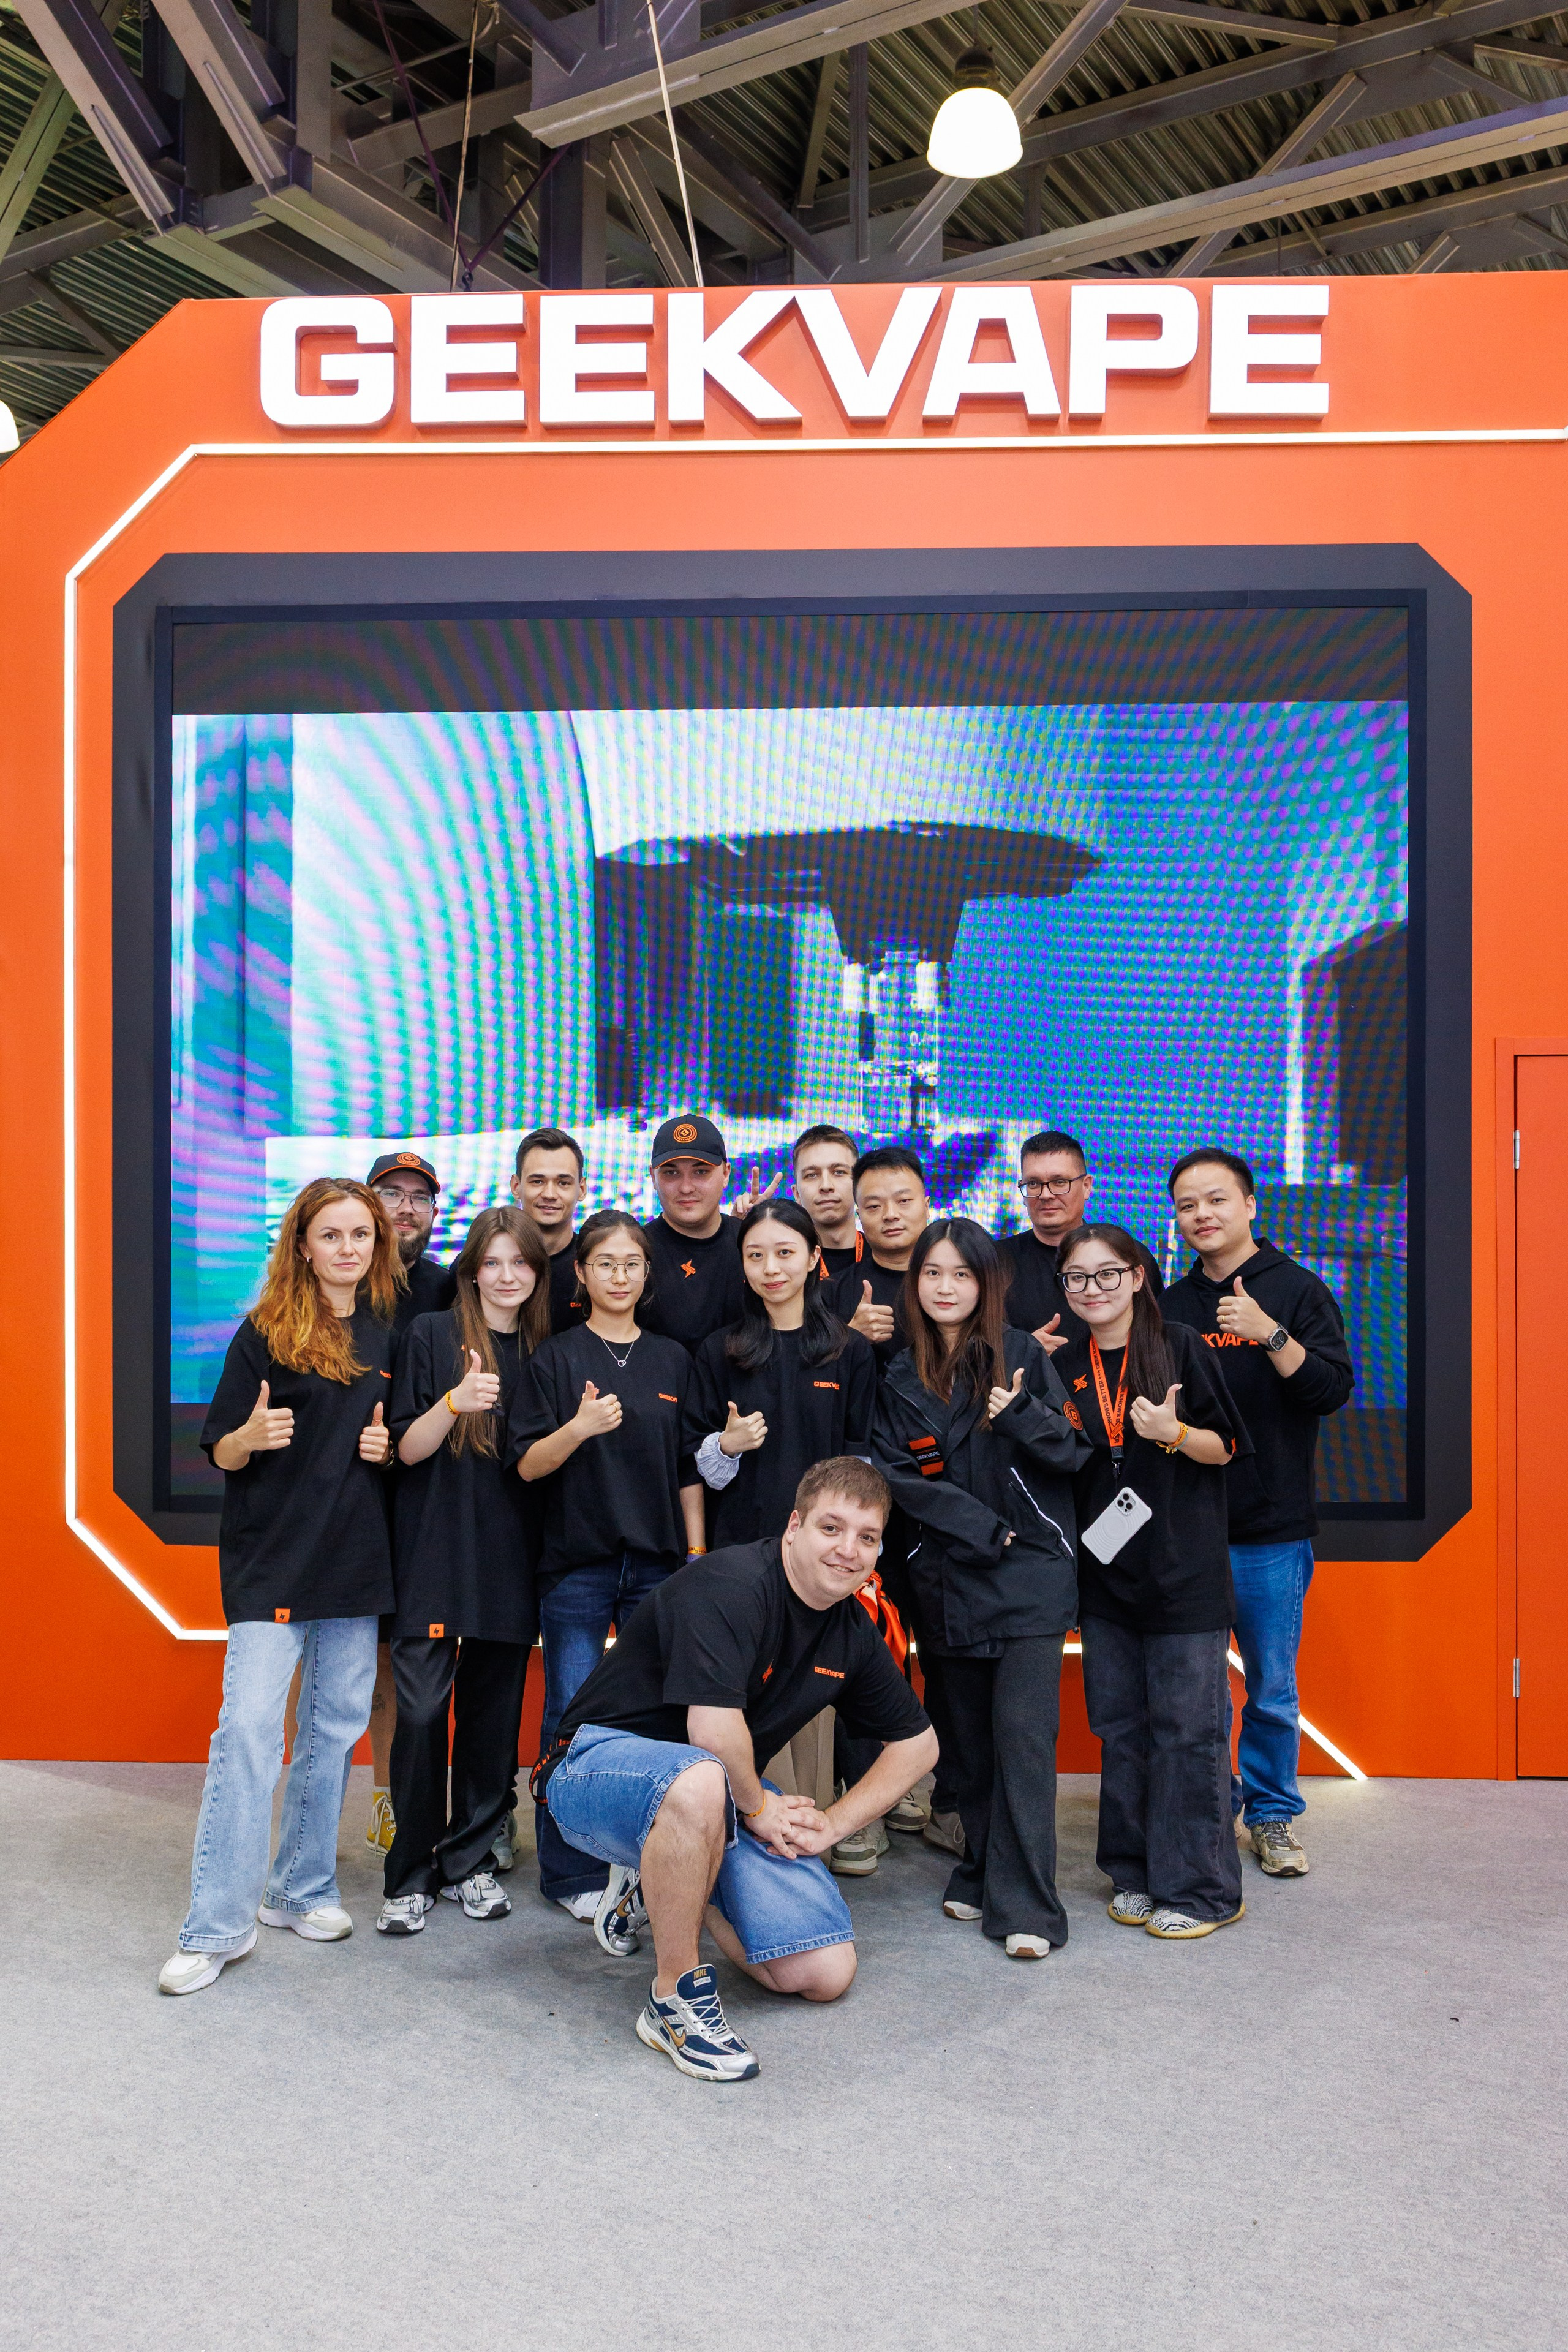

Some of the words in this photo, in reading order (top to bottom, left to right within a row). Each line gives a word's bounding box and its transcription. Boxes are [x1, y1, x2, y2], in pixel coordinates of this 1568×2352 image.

[260, 284, 1329, 430] GEEKVAPE
[1099, 1380, 1107, 1403] BETTER
[916, 1451, 940, 1460] GEEKVAPE
[814, 1665, 845, 1679] GEEKVAPE
[693, 1969, 707, 1980] NIKE
